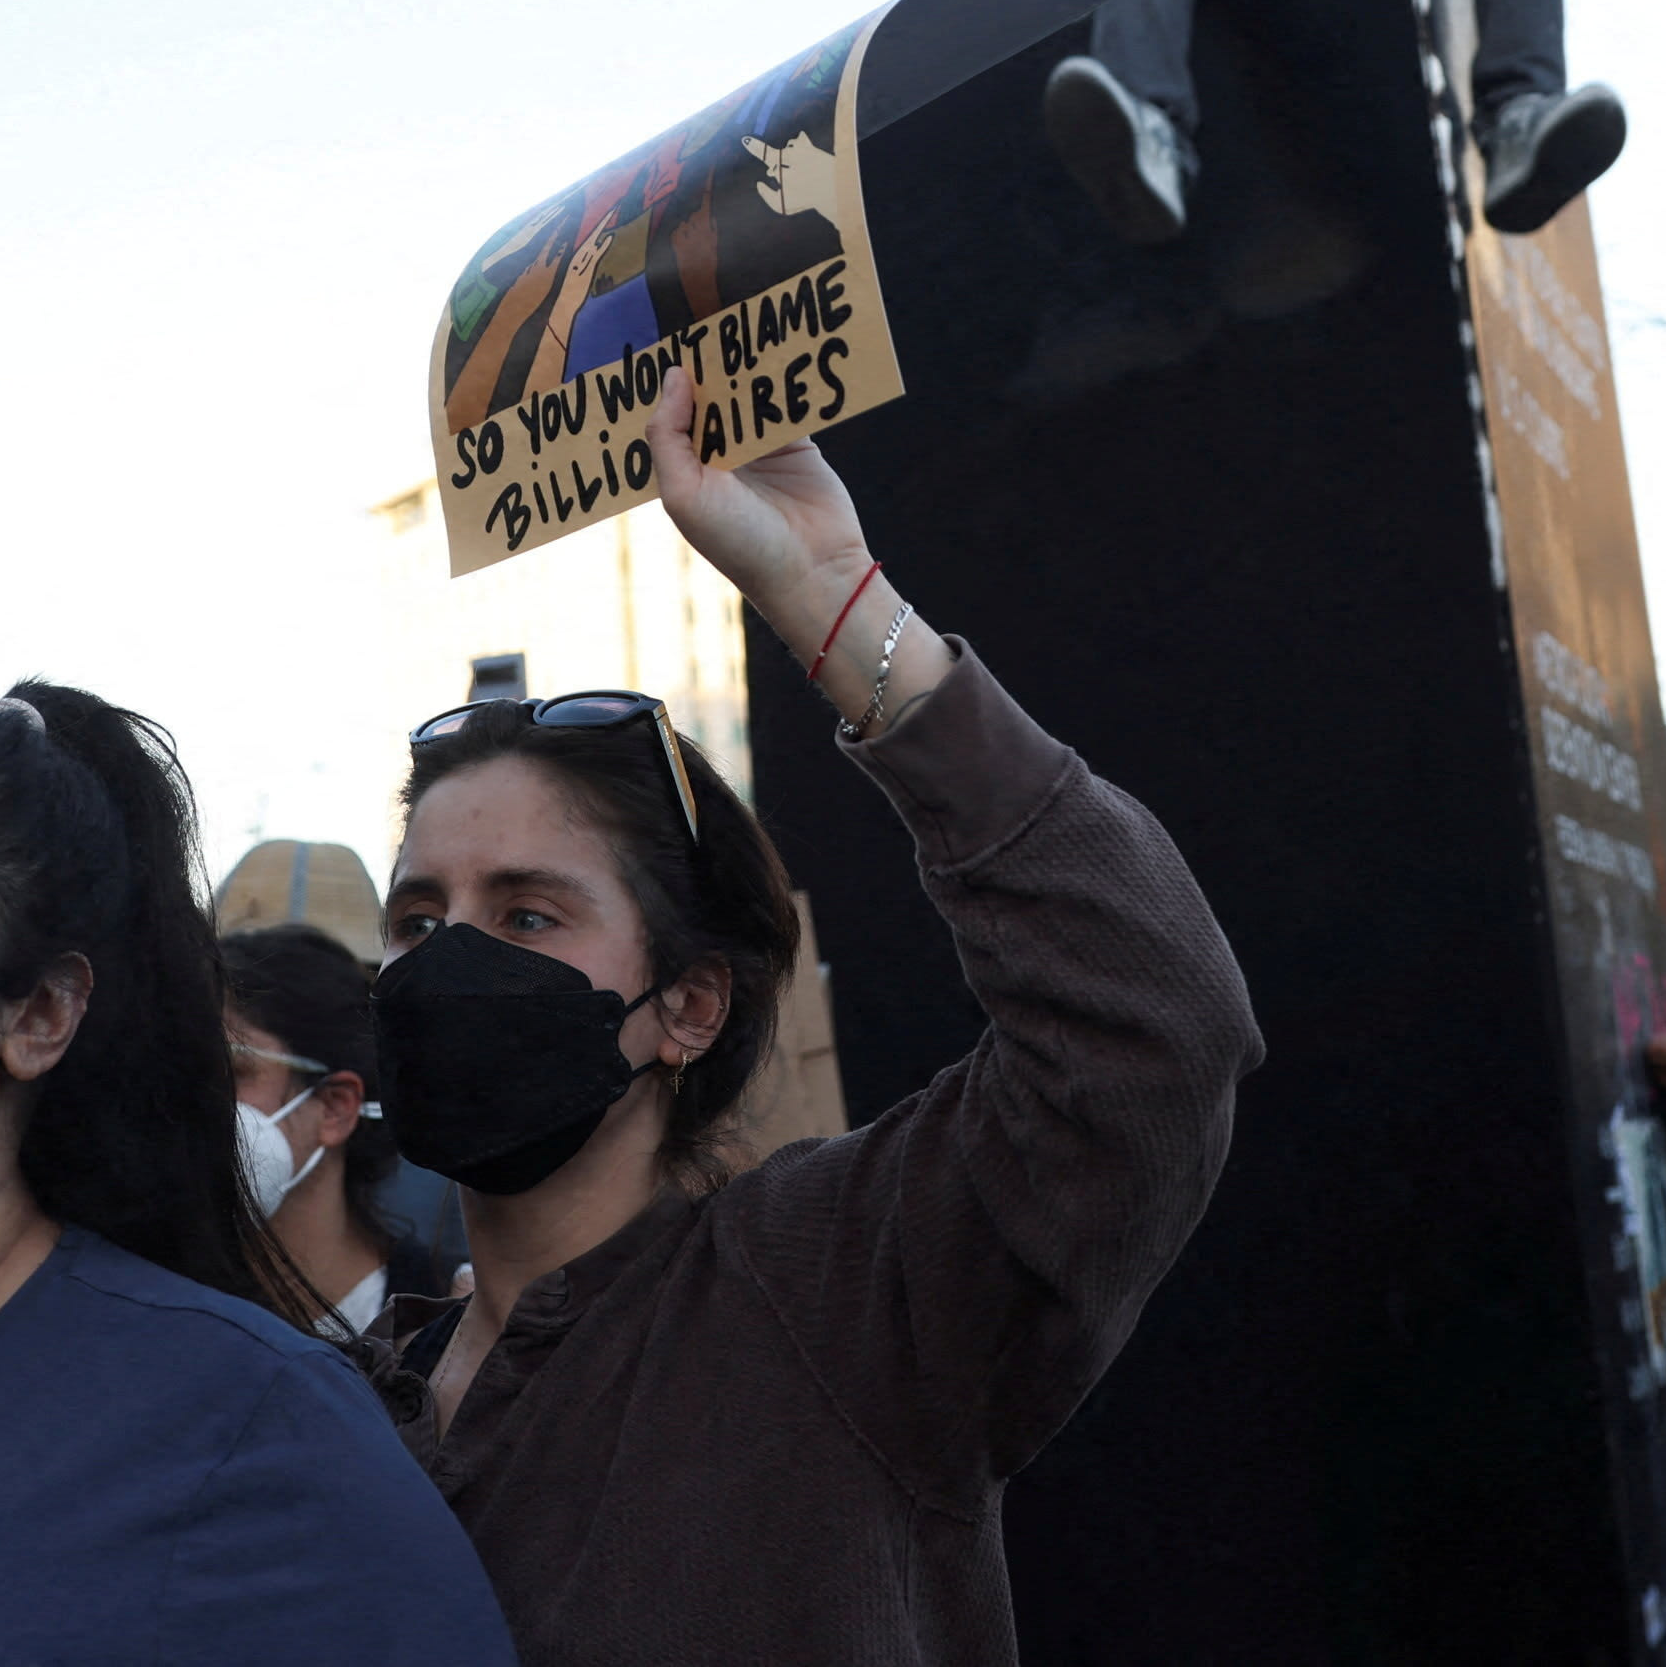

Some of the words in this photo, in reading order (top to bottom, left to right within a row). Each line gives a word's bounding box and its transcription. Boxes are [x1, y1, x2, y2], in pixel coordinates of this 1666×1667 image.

[451, 420, 505, 490] SO
[518, 373, 587, 455] YOU
[720, 259, 853, 377] BLAME
[485, 338, 850, 552] BILLIOAIRES
